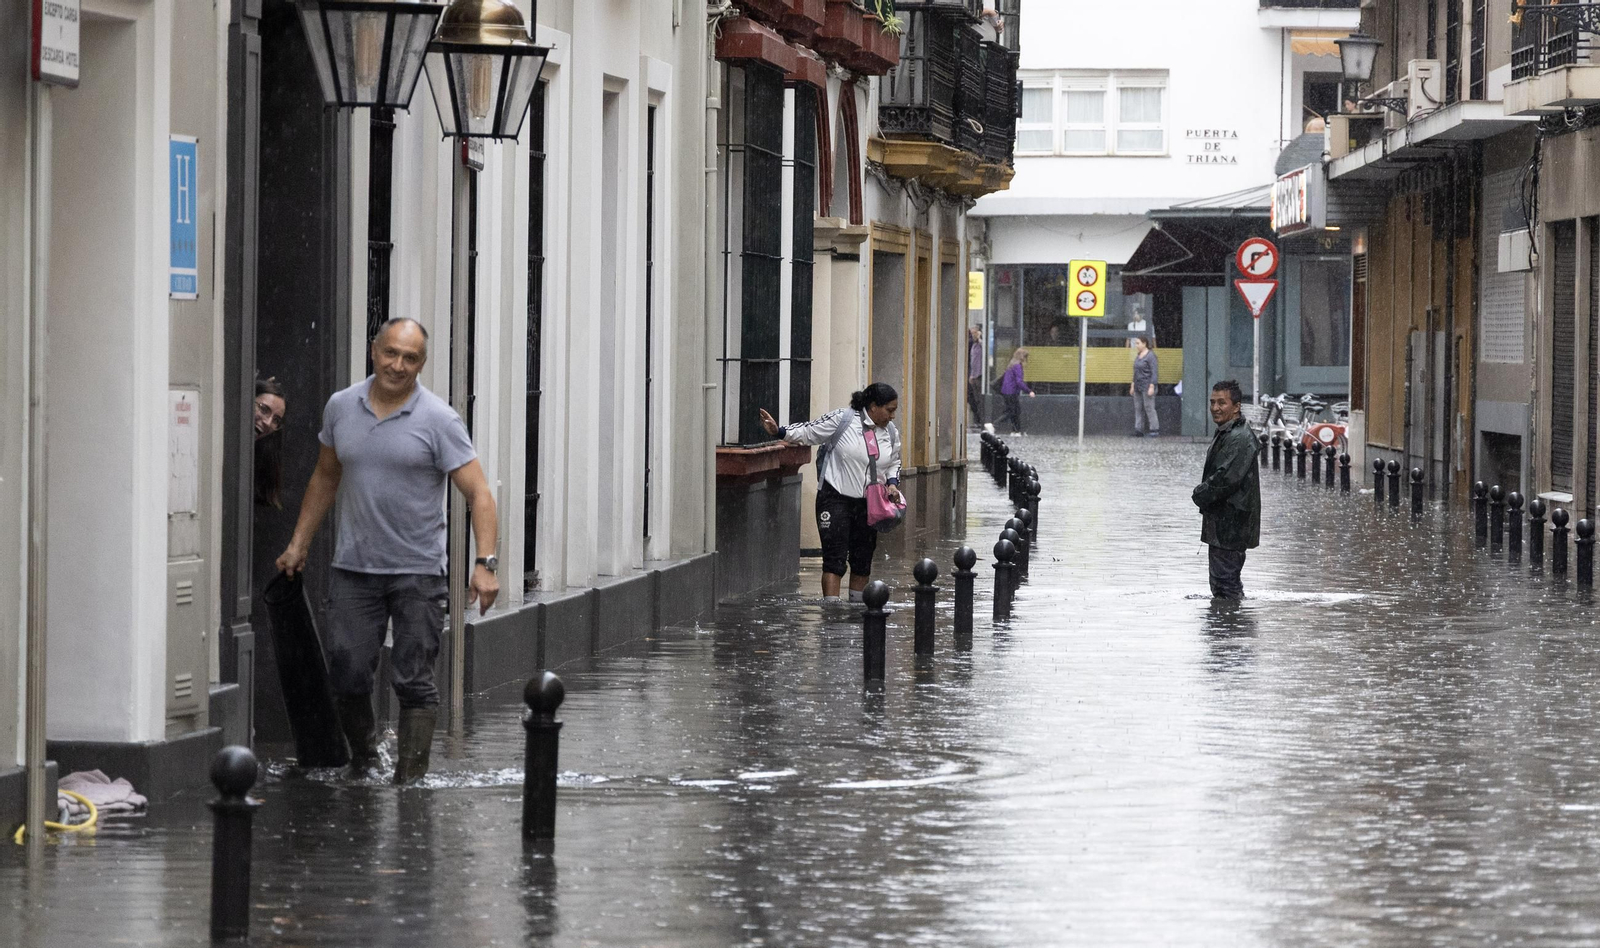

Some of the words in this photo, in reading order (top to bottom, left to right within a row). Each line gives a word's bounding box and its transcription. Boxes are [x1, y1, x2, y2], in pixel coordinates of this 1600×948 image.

[44, 1, 63, 19] EXCEPTO
[64, 6, 78, 22] CARGA
[42, 45, 64, 65] DESCARGA
[65, 51, 79, 68] HOTEL
[1186, 129, 1238, 138] PUERTA
[1204, 142, 1221, 151] DE
[1186, 154, 1237, 163] TRIANA
[175, 154, 190, 224] H
